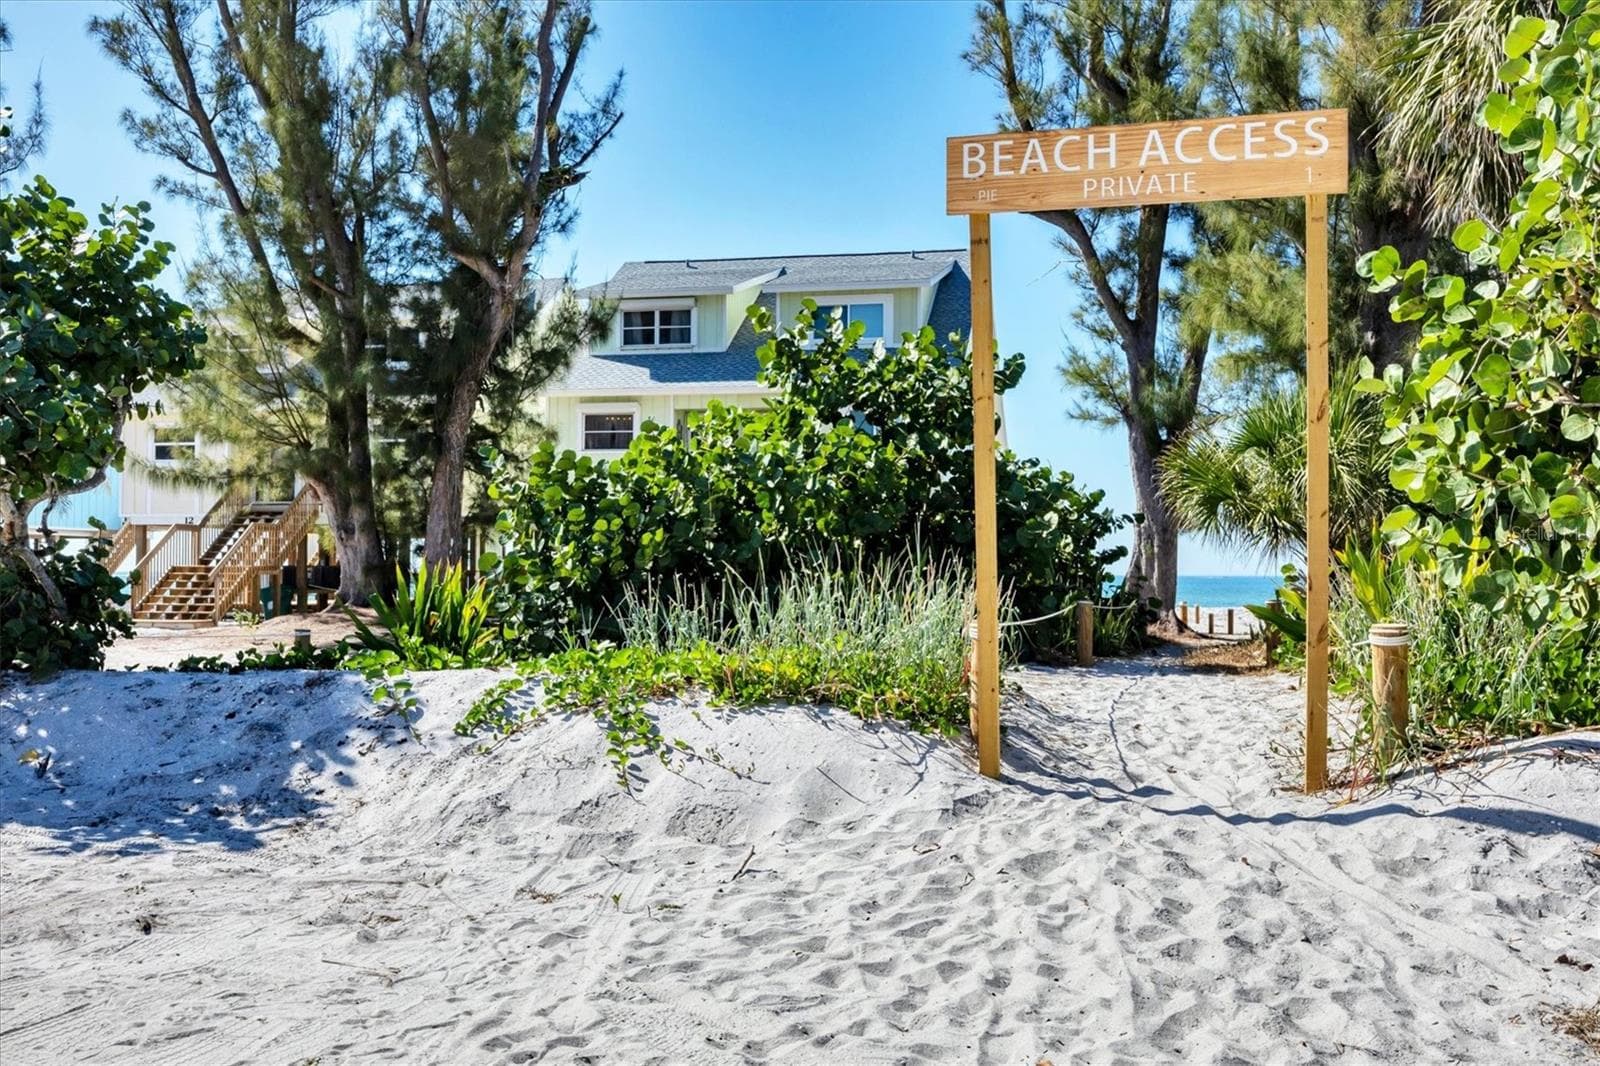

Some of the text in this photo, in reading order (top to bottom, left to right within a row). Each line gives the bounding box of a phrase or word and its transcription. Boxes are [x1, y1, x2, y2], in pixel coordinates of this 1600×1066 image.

[962, 116, 1329, 179] BEACH ACCESS
[1083, 171, 1197, 199] PRIVATE
[185, 516, 194, 524] 12
